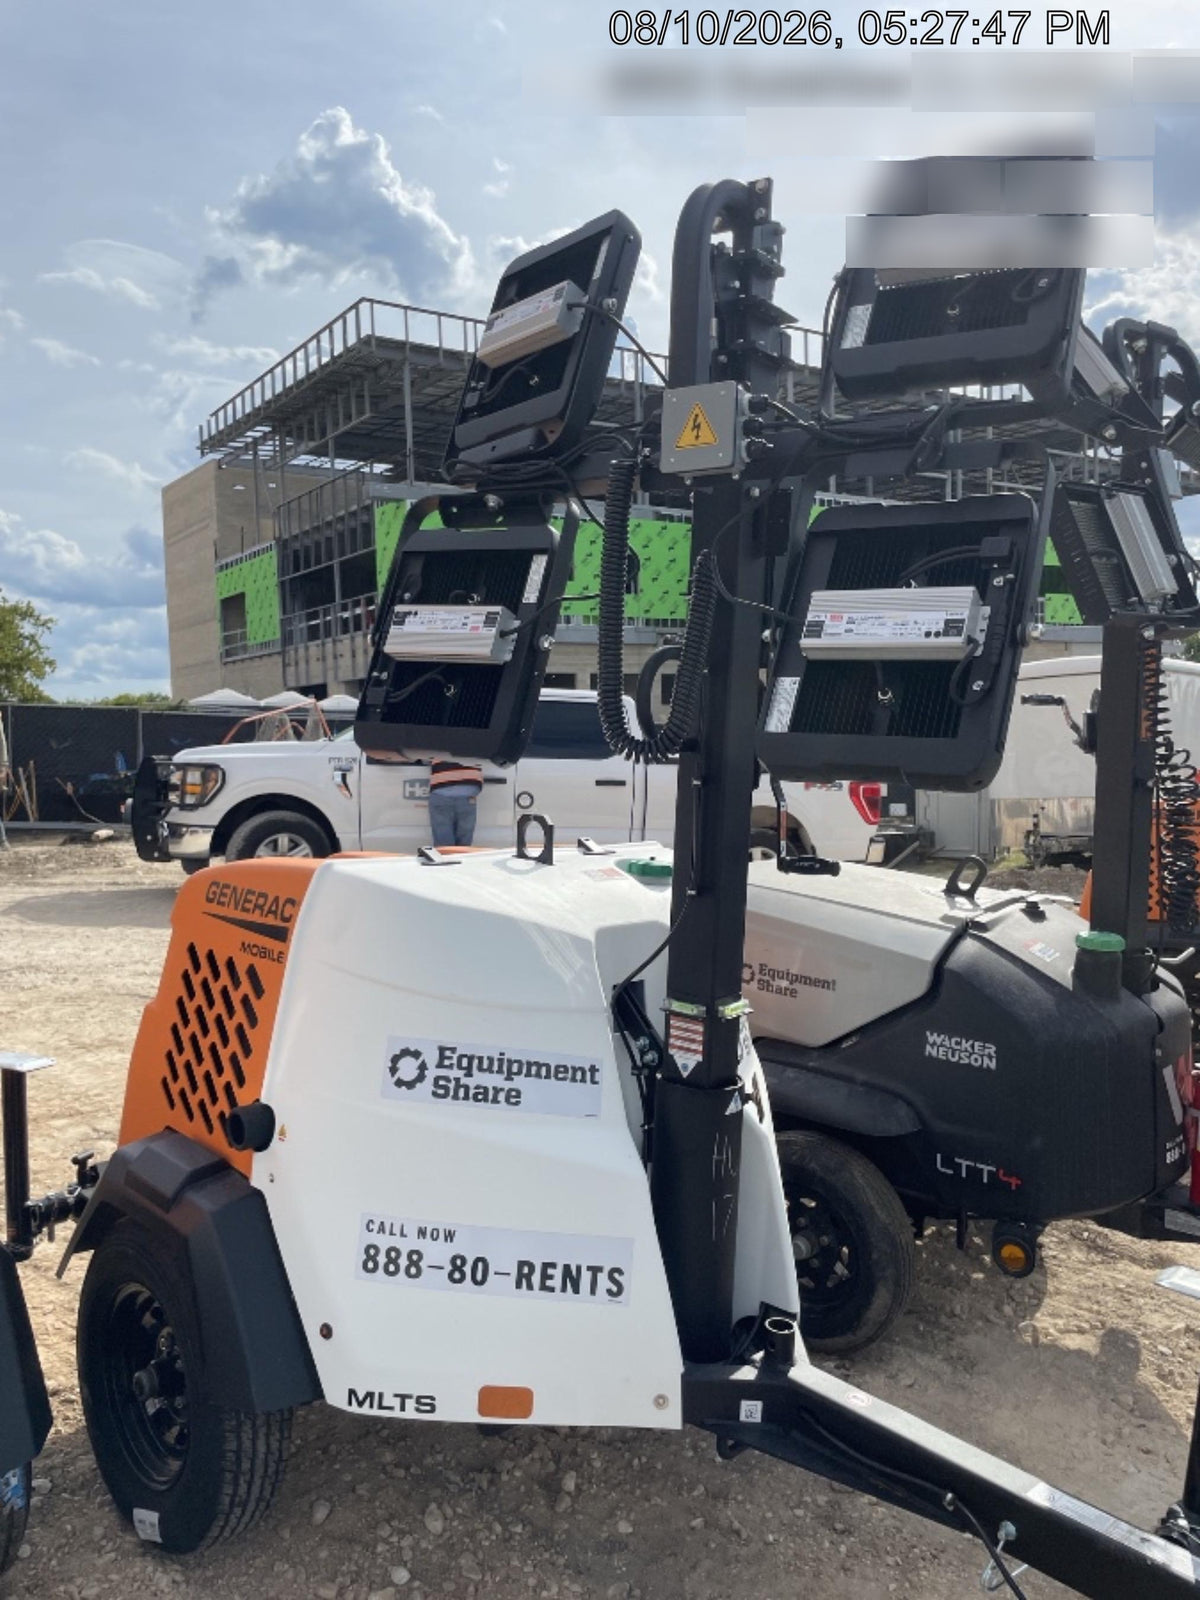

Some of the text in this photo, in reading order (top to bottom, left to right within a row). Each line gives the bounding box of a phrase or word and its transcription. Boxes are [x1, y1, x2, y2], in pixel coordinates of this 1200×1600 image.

[205, 880, 297, 923] GENERAC
[239, 941, 286, 964] MOBILE
[756, 978, 799, 998] Share
[758, 963, 837, 992] Equipment
[925, 1044, 997, 1071] NEUSON
[926, 1030, 997, 1057] WACKER
[434, 1044, 600, 1085] Equipment
[431, 1074, 522, 1106] Share
[936, 1152, 1022, 1191] LTT4
[365, 1218, 457, 1244] CALL NOW
[361, 1243, 626, 1299] 888-80-RENTS
[347, 1387, 437, 1414] MLTS
